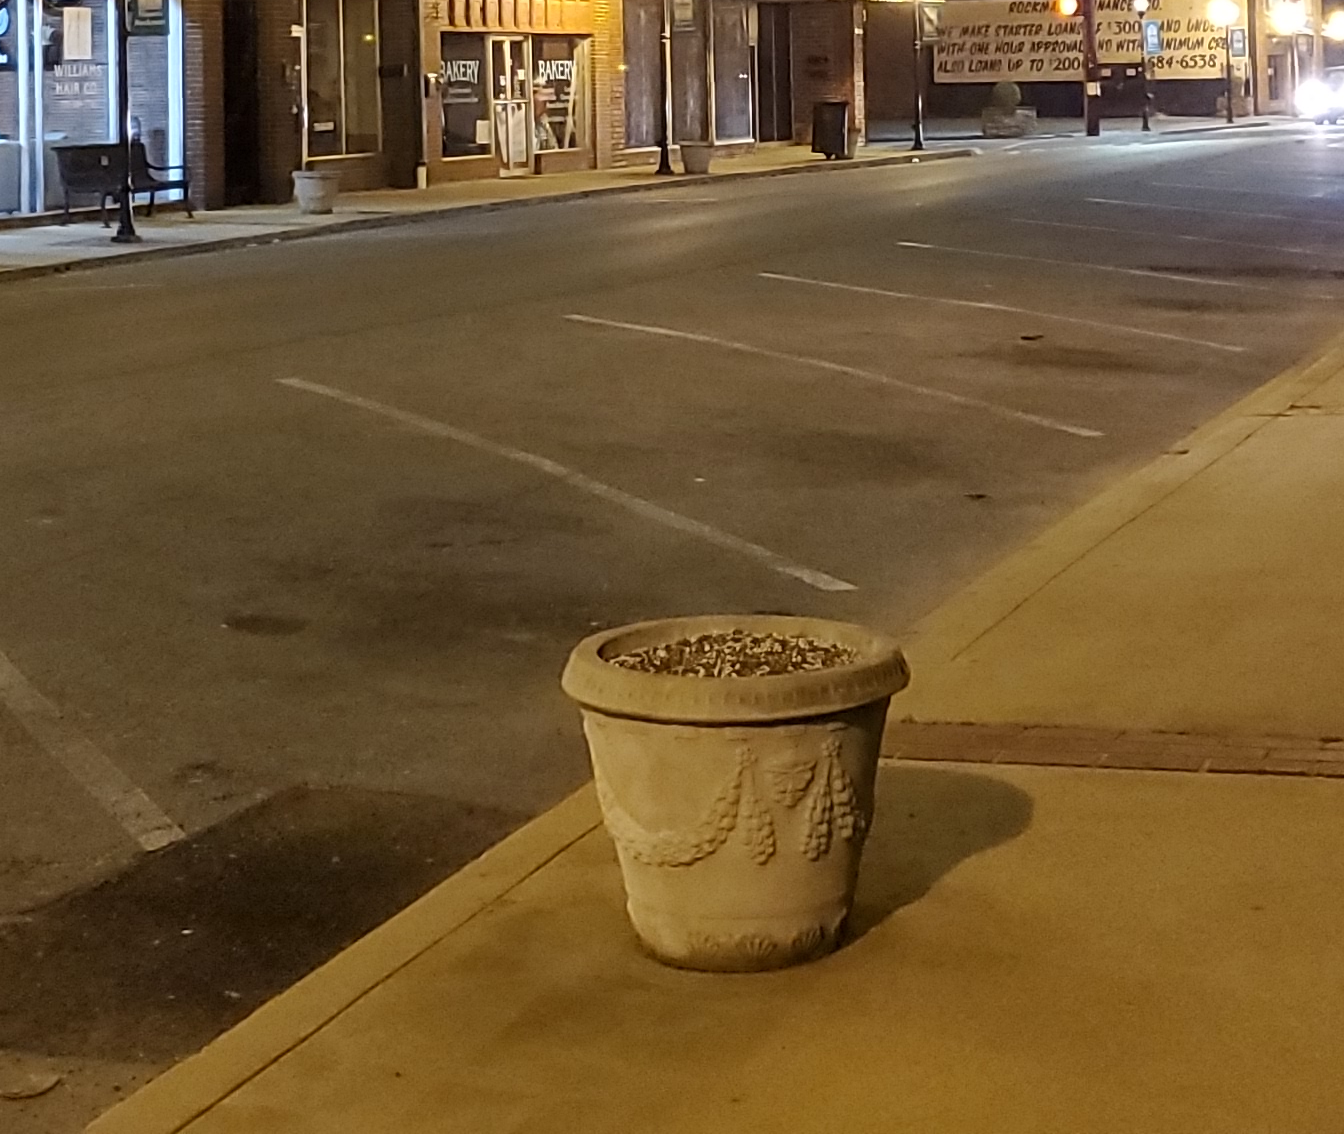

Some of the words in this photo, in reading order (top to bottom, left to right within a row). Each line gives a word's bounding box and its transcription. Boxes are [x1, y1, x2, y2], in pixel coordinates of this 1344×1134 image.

[1008, 0, 1061, 14] ROCKMA
[959, 24, 990, 38] MAKE
[994, 23, 1043, 37] STARTER
[1047, 21, 1083, 36] LOANS
[937, 40, 966, 56] WITH
[969, 40, 990, 55] ONE
[994, 40, 1025, 55] HOUR
[1029, 39, 1083, 54] APPROVAL
[1160, 36, 1204, 52] INIMUM
[53, 64, 103, 77] WILLIAMS
[440, 59, 480, 85] BAKERY
[538, 59, 576, 81] BAKERY
[937, 59, 965, 74] ALSO
[968, 58, 1002, 74] LOANS
[1007, 58, 1024, 73] UP
[1029, 58, 1044, 72] TO
[55, 81, 81, 95] HAIR
